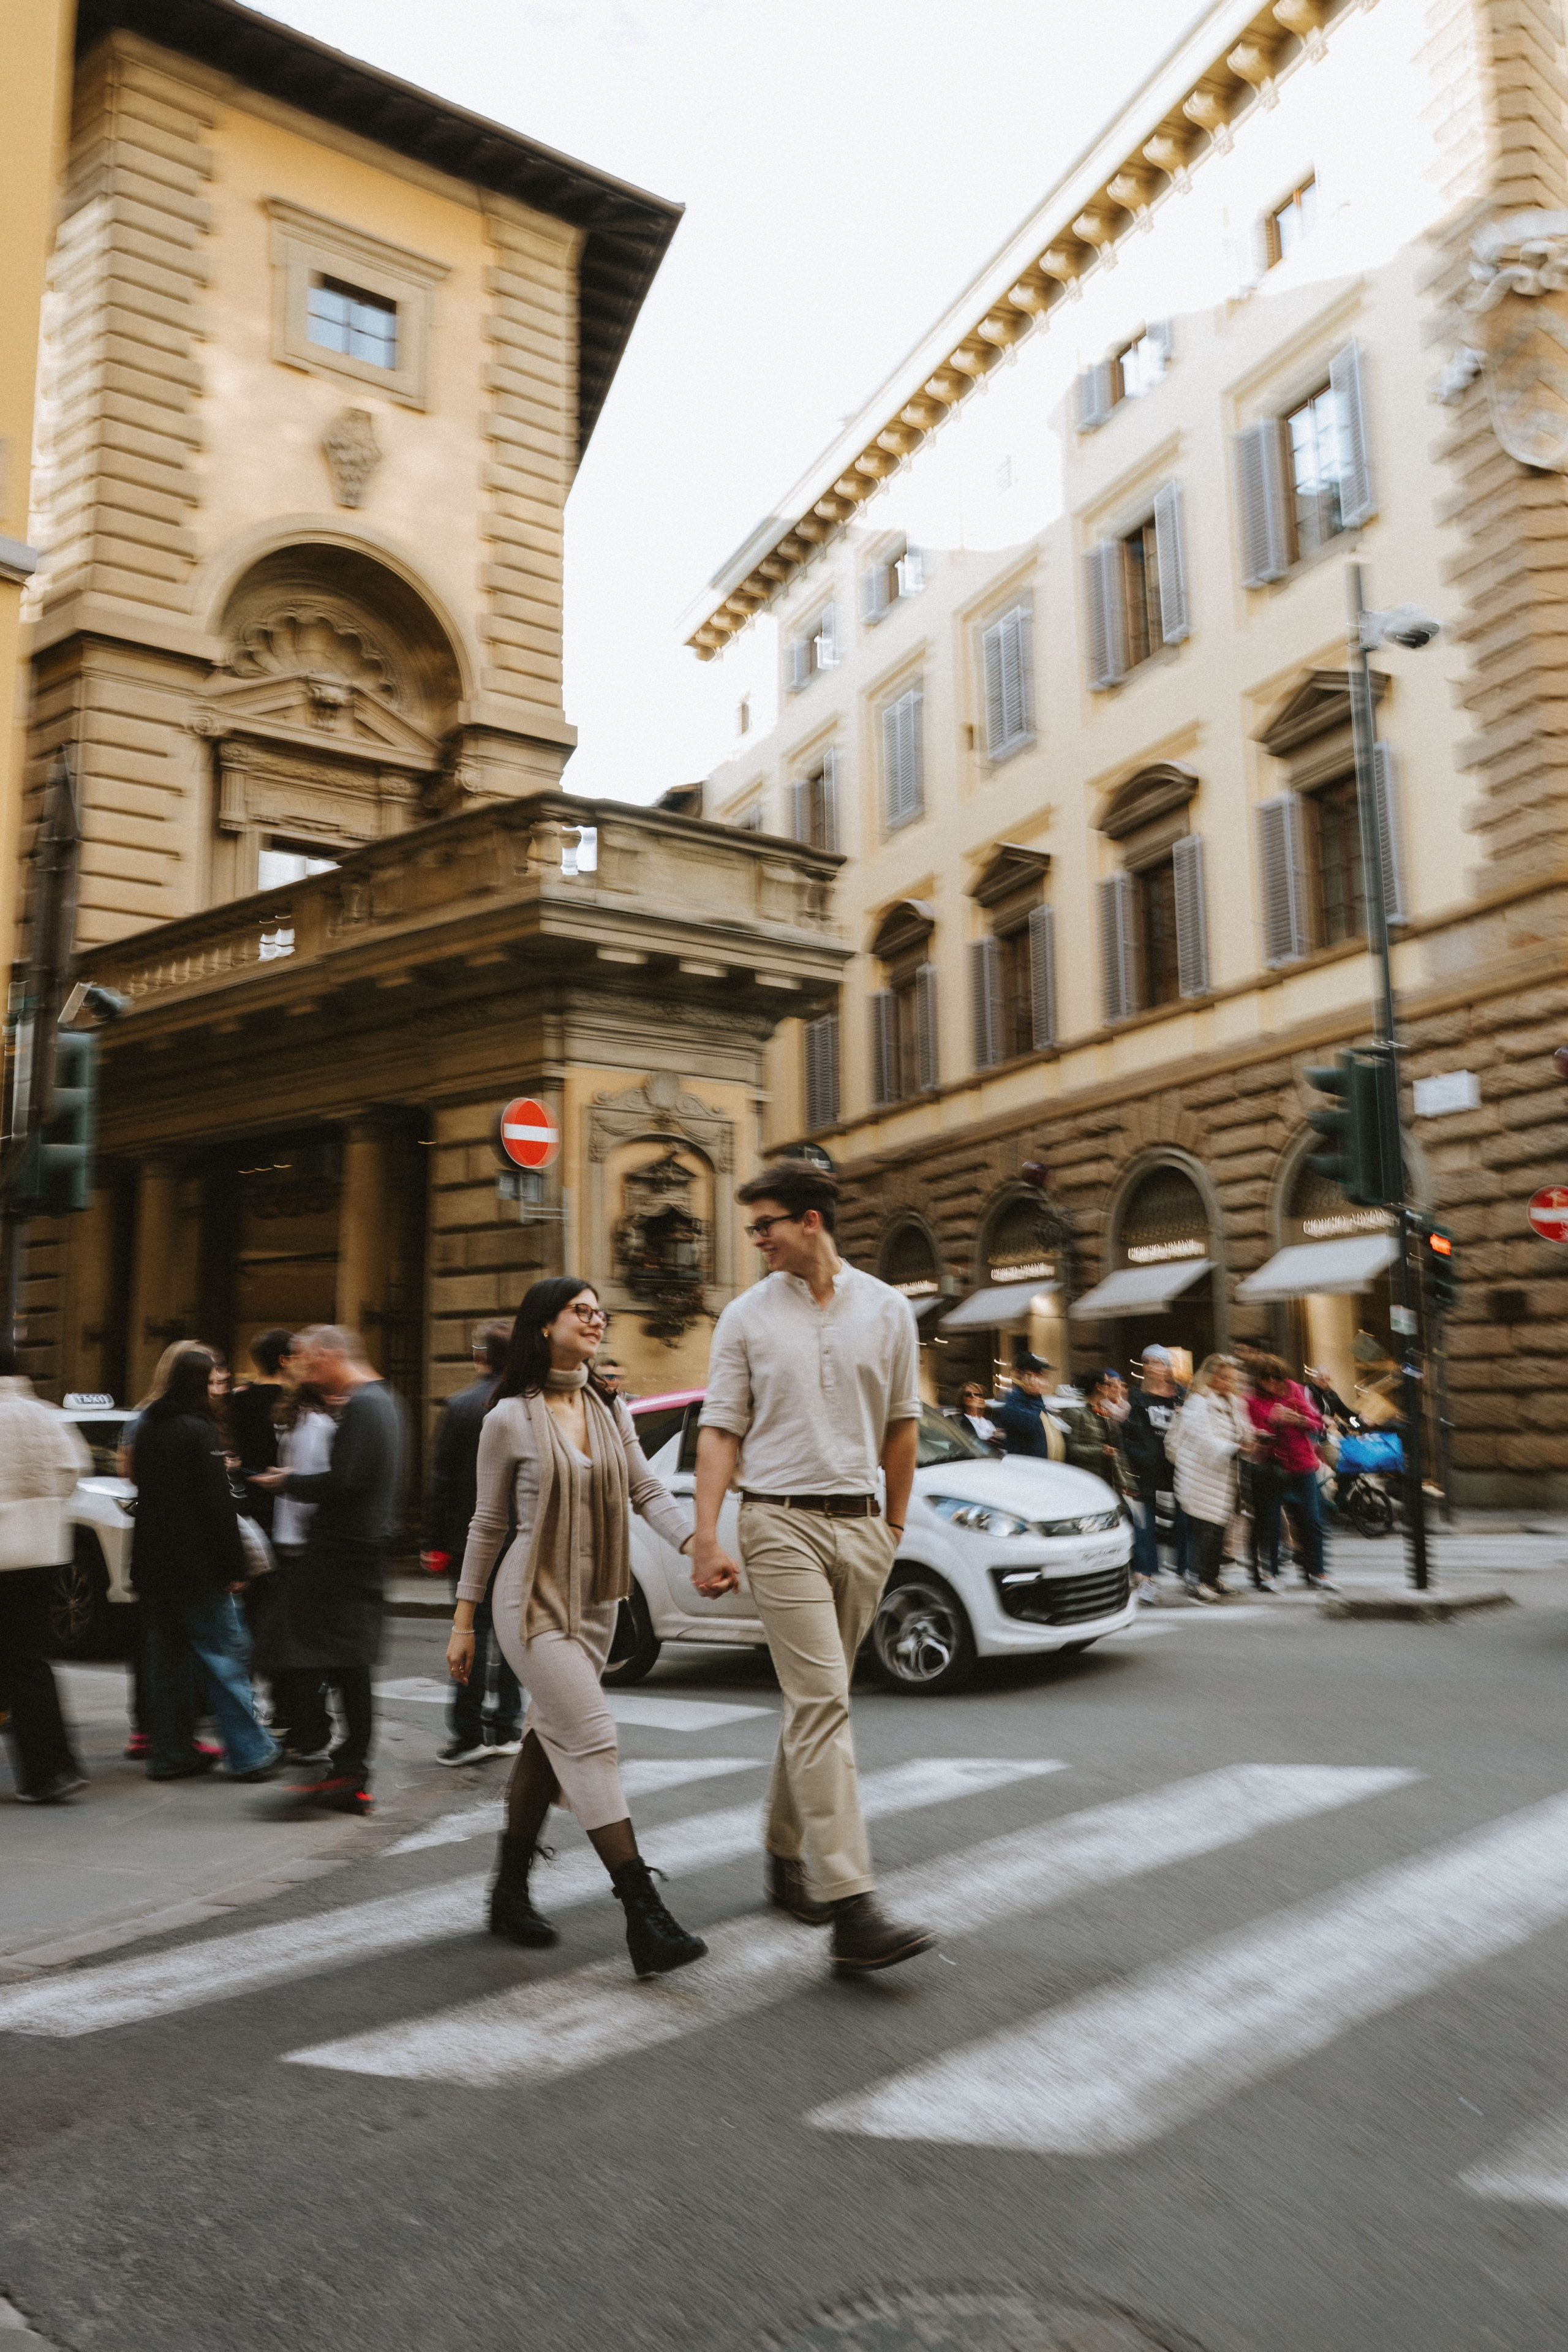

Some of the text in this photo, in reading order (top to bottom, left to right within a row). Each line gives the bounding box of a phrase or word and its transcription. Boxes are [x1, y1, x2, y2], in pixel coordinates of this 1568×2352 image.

[1302, 1208, 1400, 1238] GIORGIO ARMAN
[1128, 1238, 1205, 1263] GIORGIO ARMANI
[74, 1395, 108, 1404] TAXI
